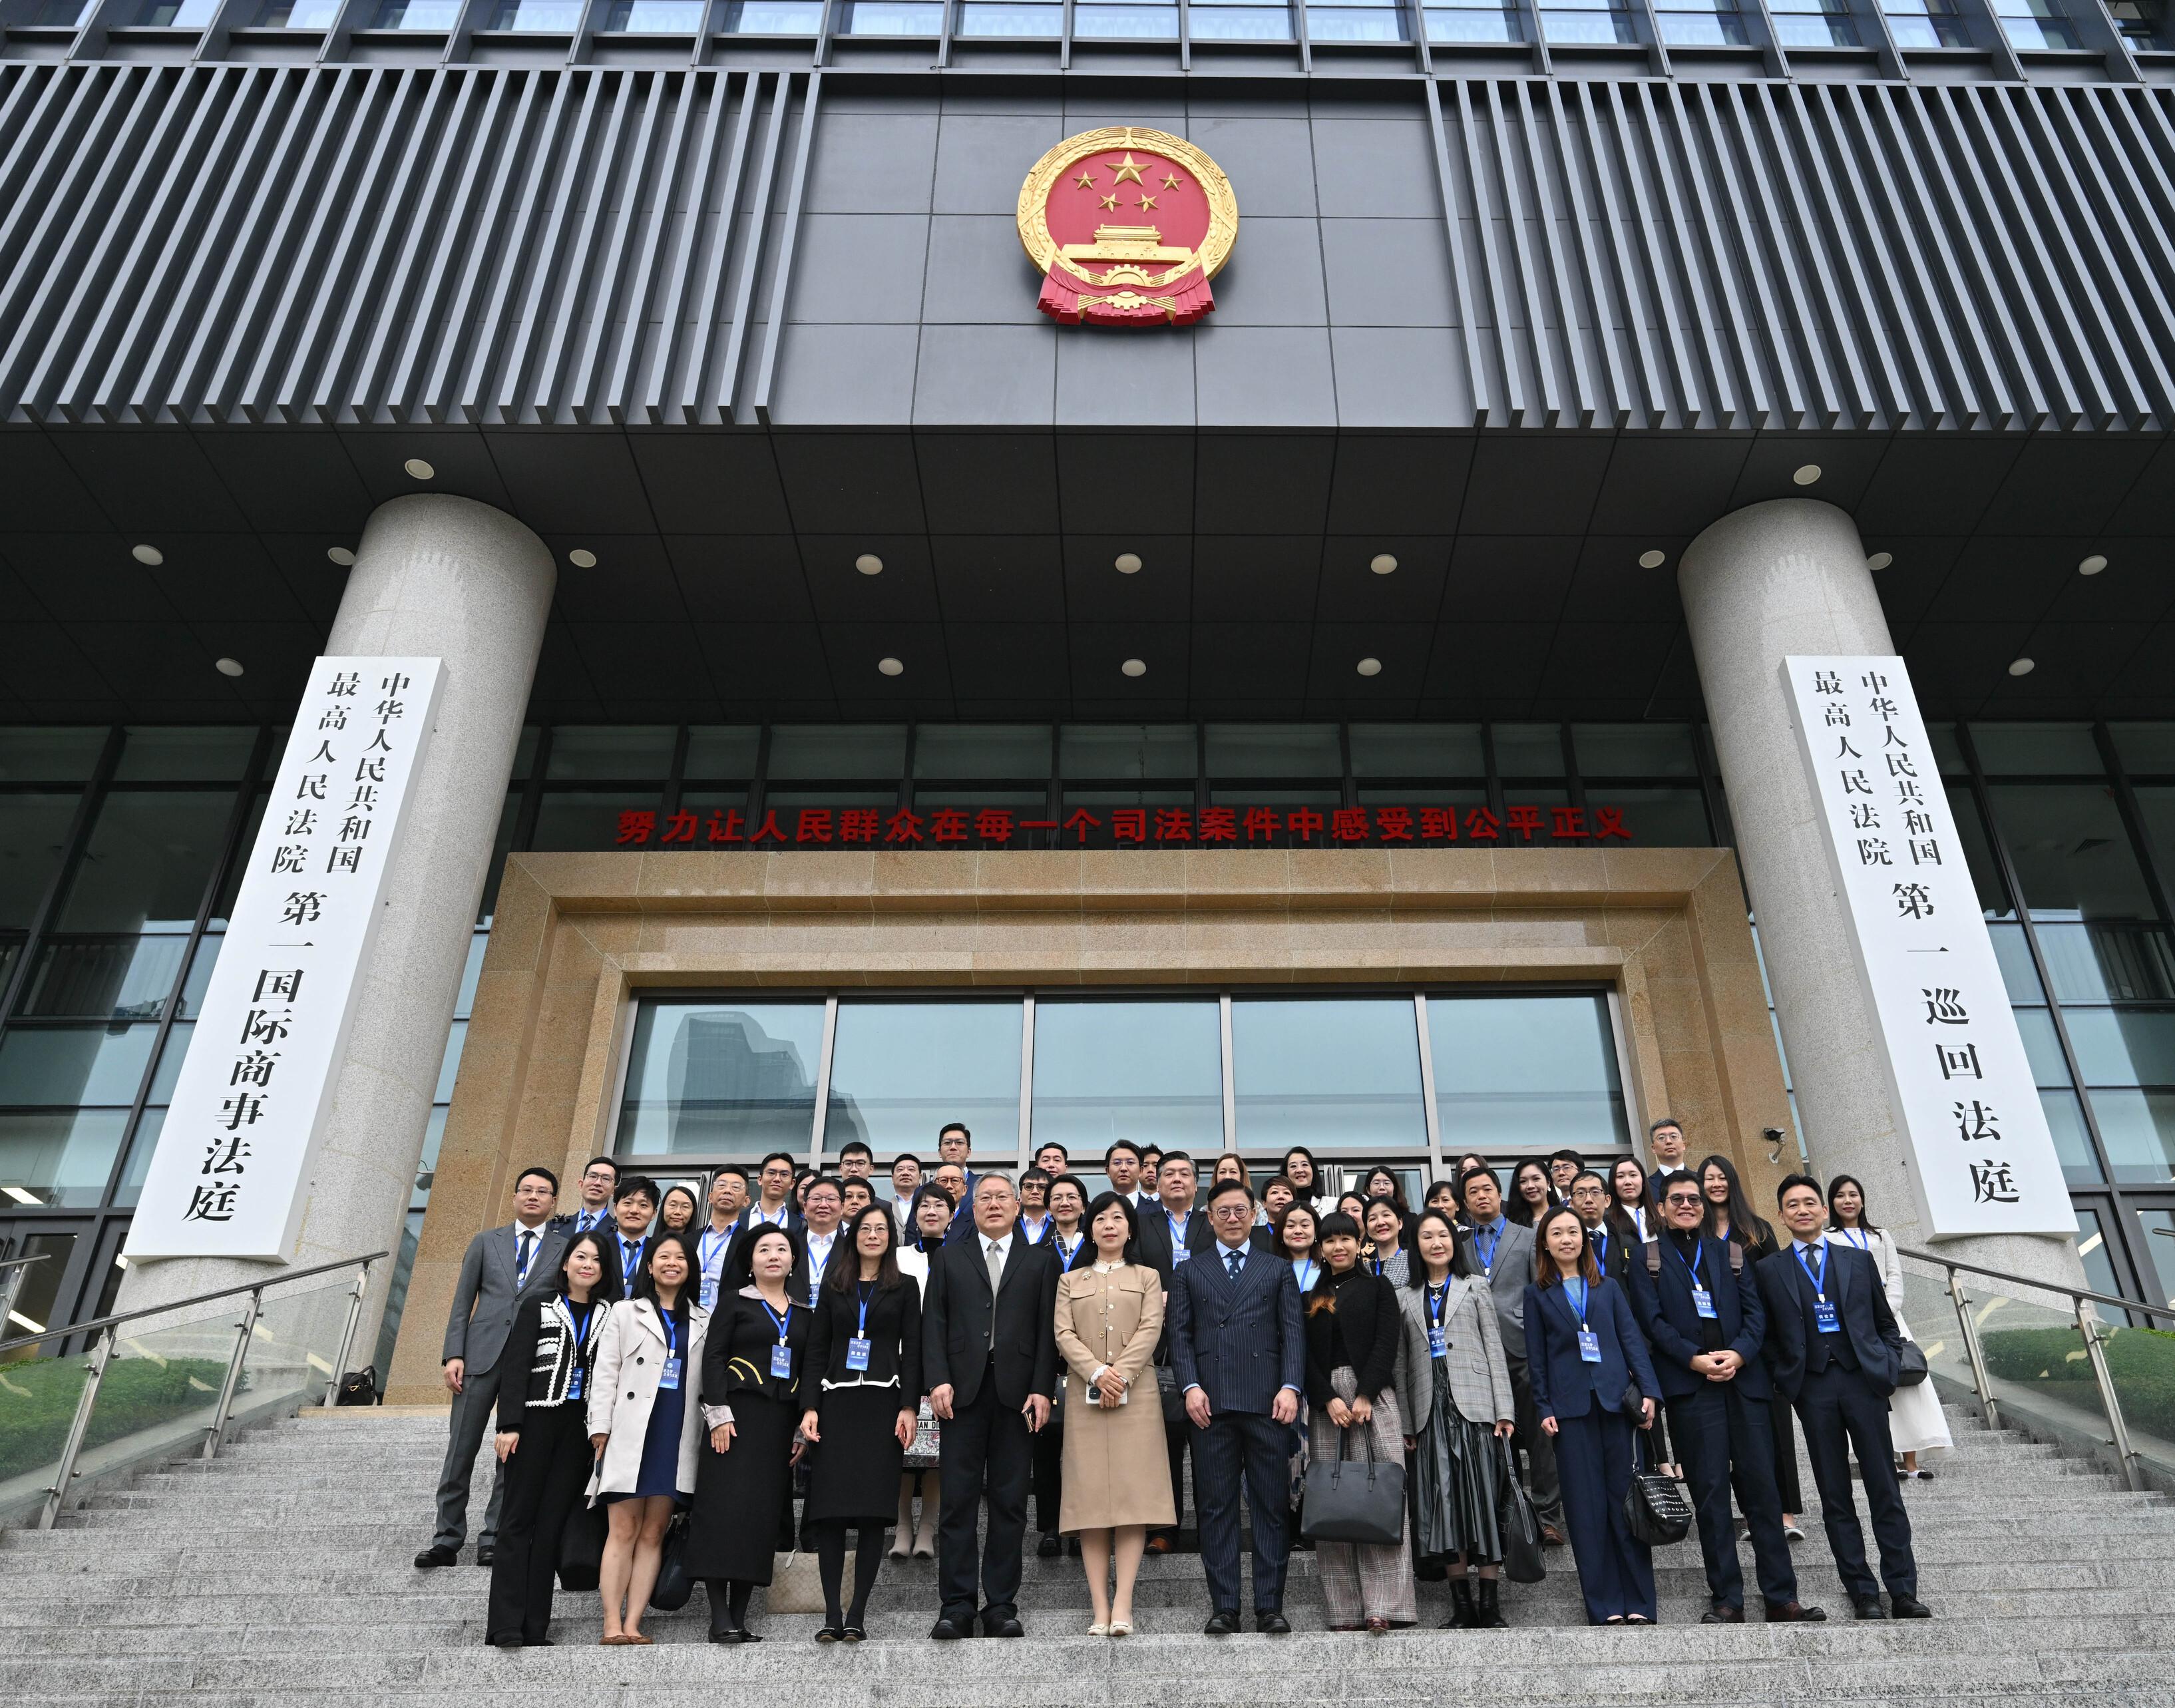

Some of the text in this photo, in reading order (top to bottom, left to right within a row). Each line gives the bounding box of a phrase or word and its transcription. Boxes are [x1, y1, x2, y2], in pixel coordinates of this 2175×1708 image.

[271, 672, 361, 873] 最高人民法院
[326, 672, 411, 873] 中华人民共和国
[615, 805, 1633, 844] 努力让人民群众在每一个司法案件中感受到公平正义
[1812, 670, 1893, 865] 最高人民法院
[1861, 671, 1942, 865] 中华人民共和国
[182, 891, 327, 1221] 第一国际商事法庭
[1892, 883, 2020, 1203] 第一巡回法庭
